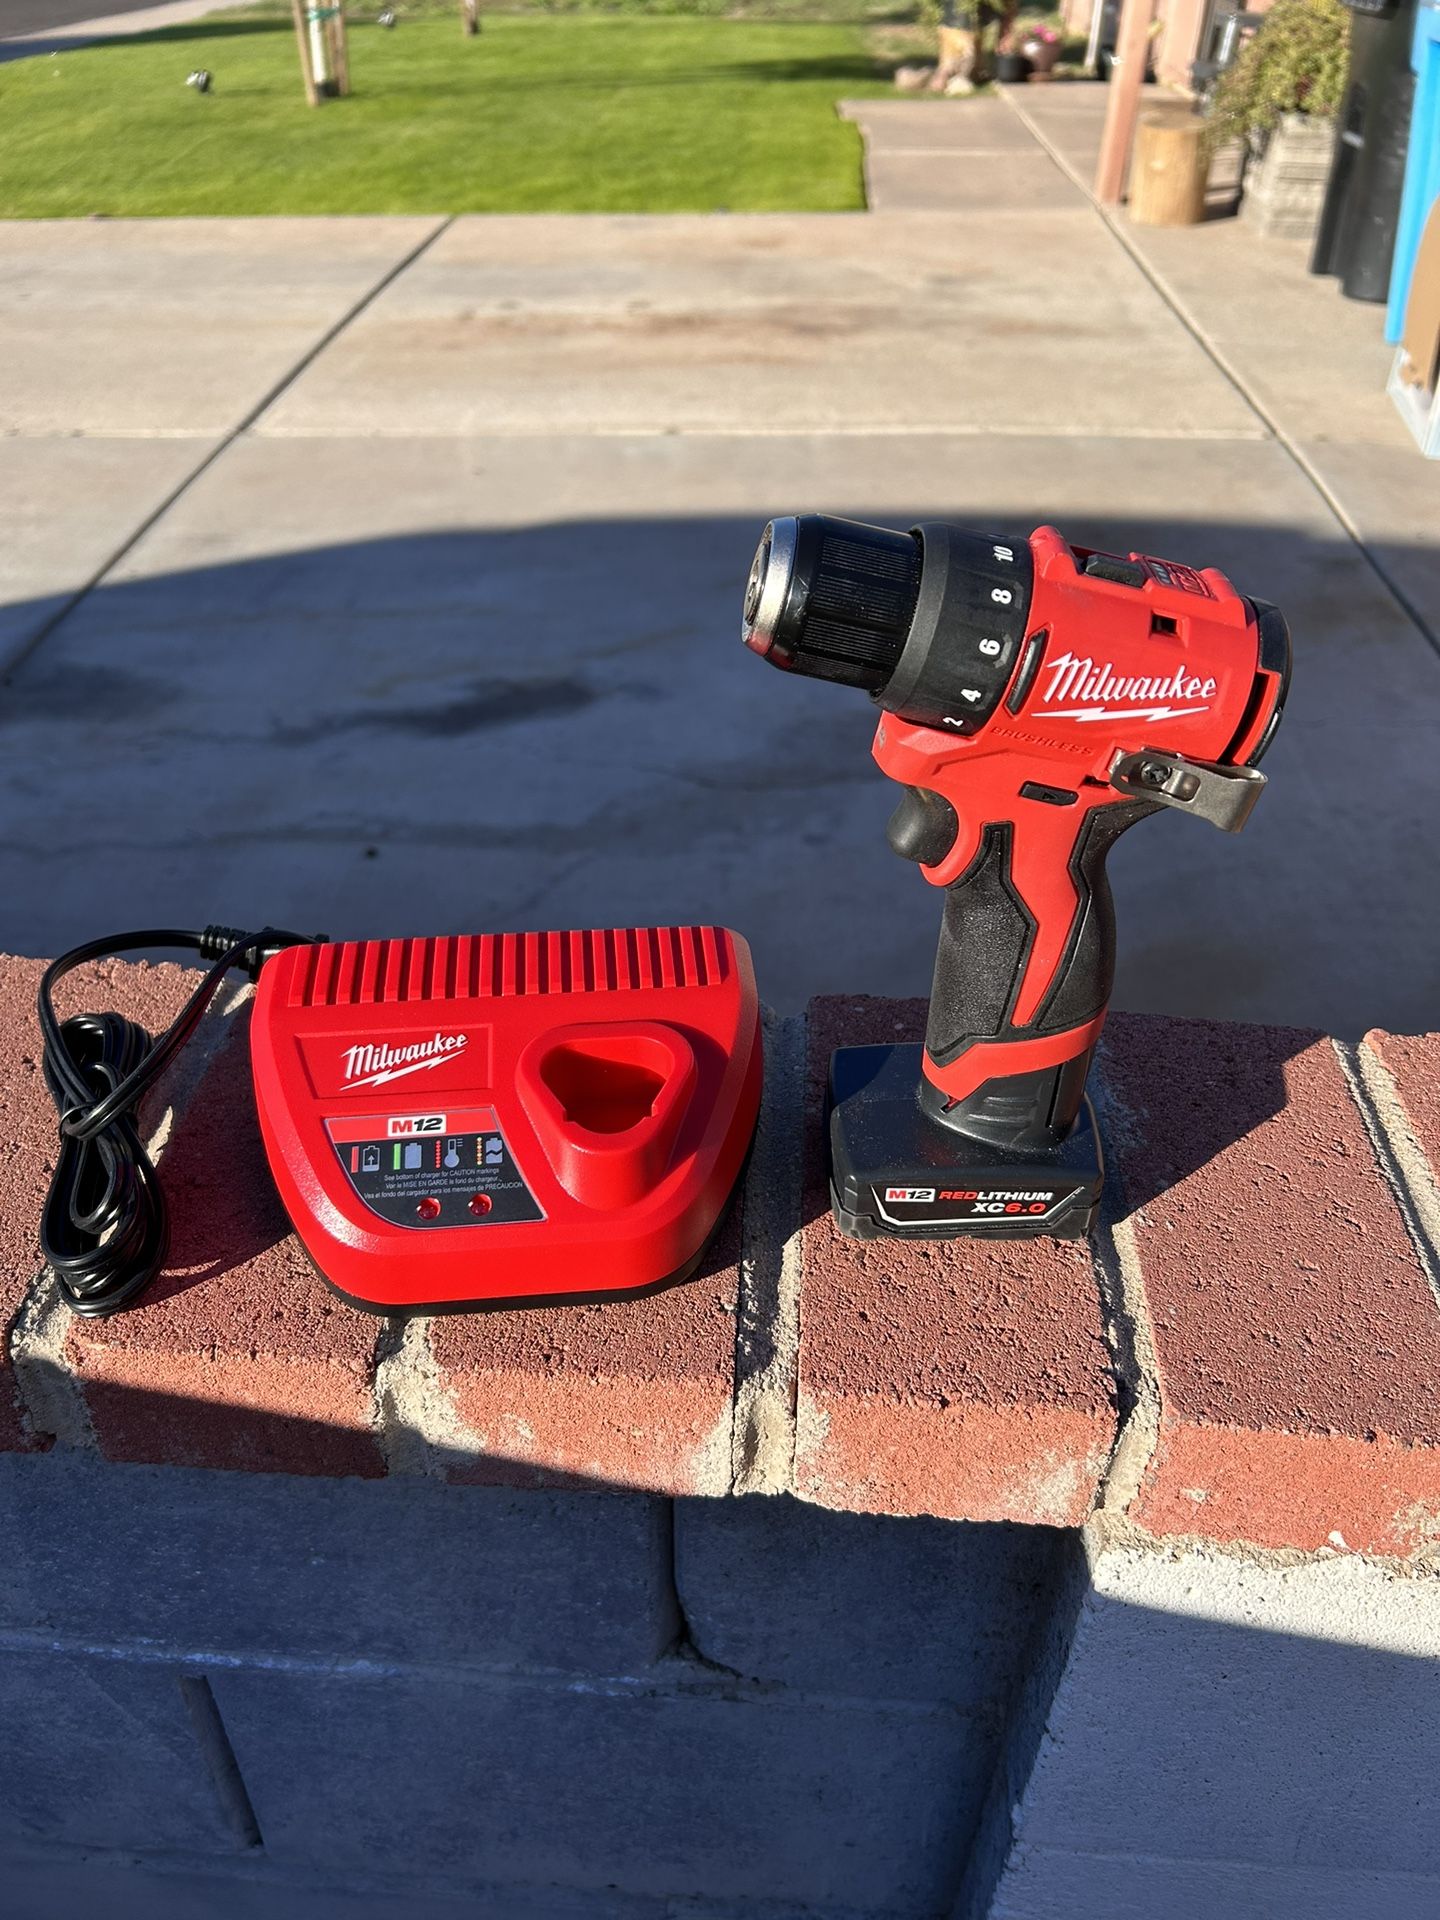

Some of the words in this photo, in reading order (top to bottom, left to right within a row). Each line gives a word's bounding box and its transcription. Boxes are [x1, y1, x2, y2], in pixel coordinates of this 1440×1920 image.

[993, 545, 1014, 563] 10
[991, 588, 1012, 605] 8
[978, 638, 1001, 656] 6
[1043, 651, 1217, 703] Milwaukee
[960, 688, 982, 703] 4
[943, 716, 964, 727] 2
[990, 726, 1095, 756] BRUSHLESS
[340, 1032, 469, 1080] Milwaukee
[391, 1117, 444, 1134] M12
[421, 1171, 441, 1179] charger
[887, 1190, 932, 1200] M12
[938, 1191, 1053, 1201] REDLITHIUM
[970, 1202, 1047, 1214] XC6.0
